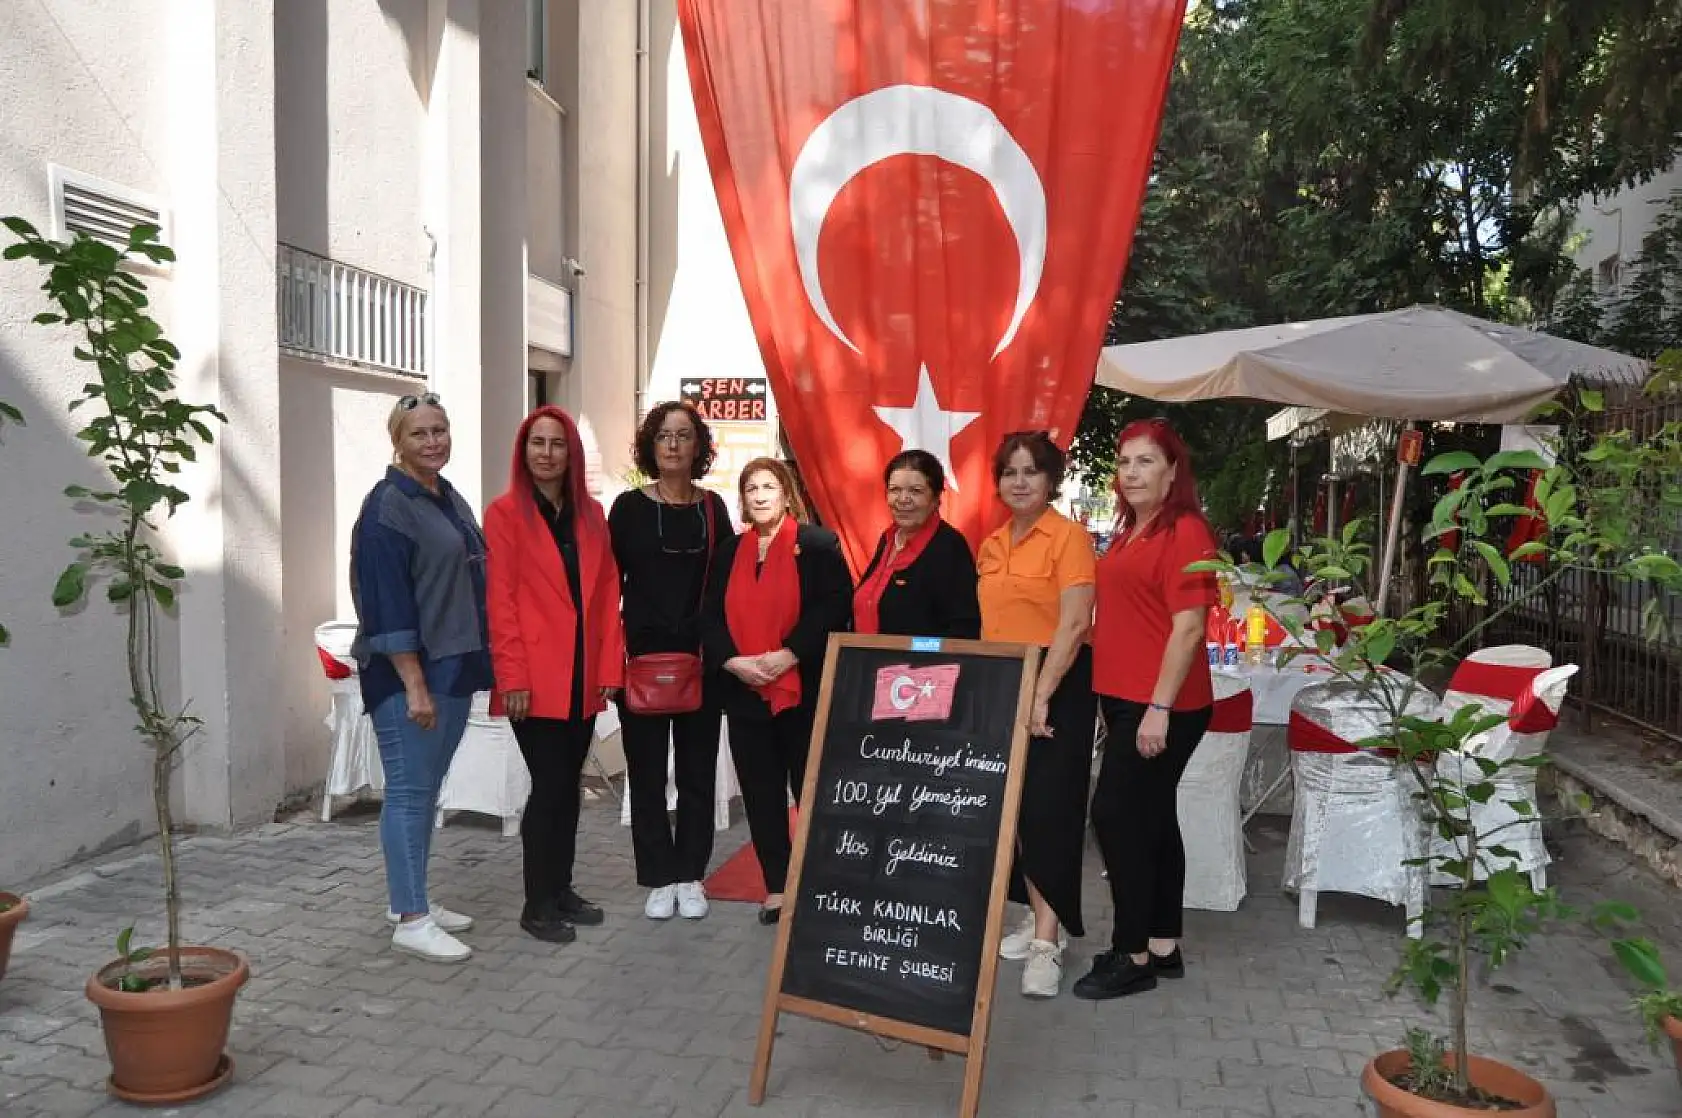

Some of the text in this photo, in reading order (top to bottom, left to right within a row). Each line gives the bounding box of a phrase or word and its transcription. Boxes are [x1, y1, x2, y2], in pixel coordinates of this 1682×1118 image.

[682, 399, 765, 420] ARBER
[886, 839, 959, 875] Geldiniz
[815, 890, 961, 931] TÜRK KADINLAR
